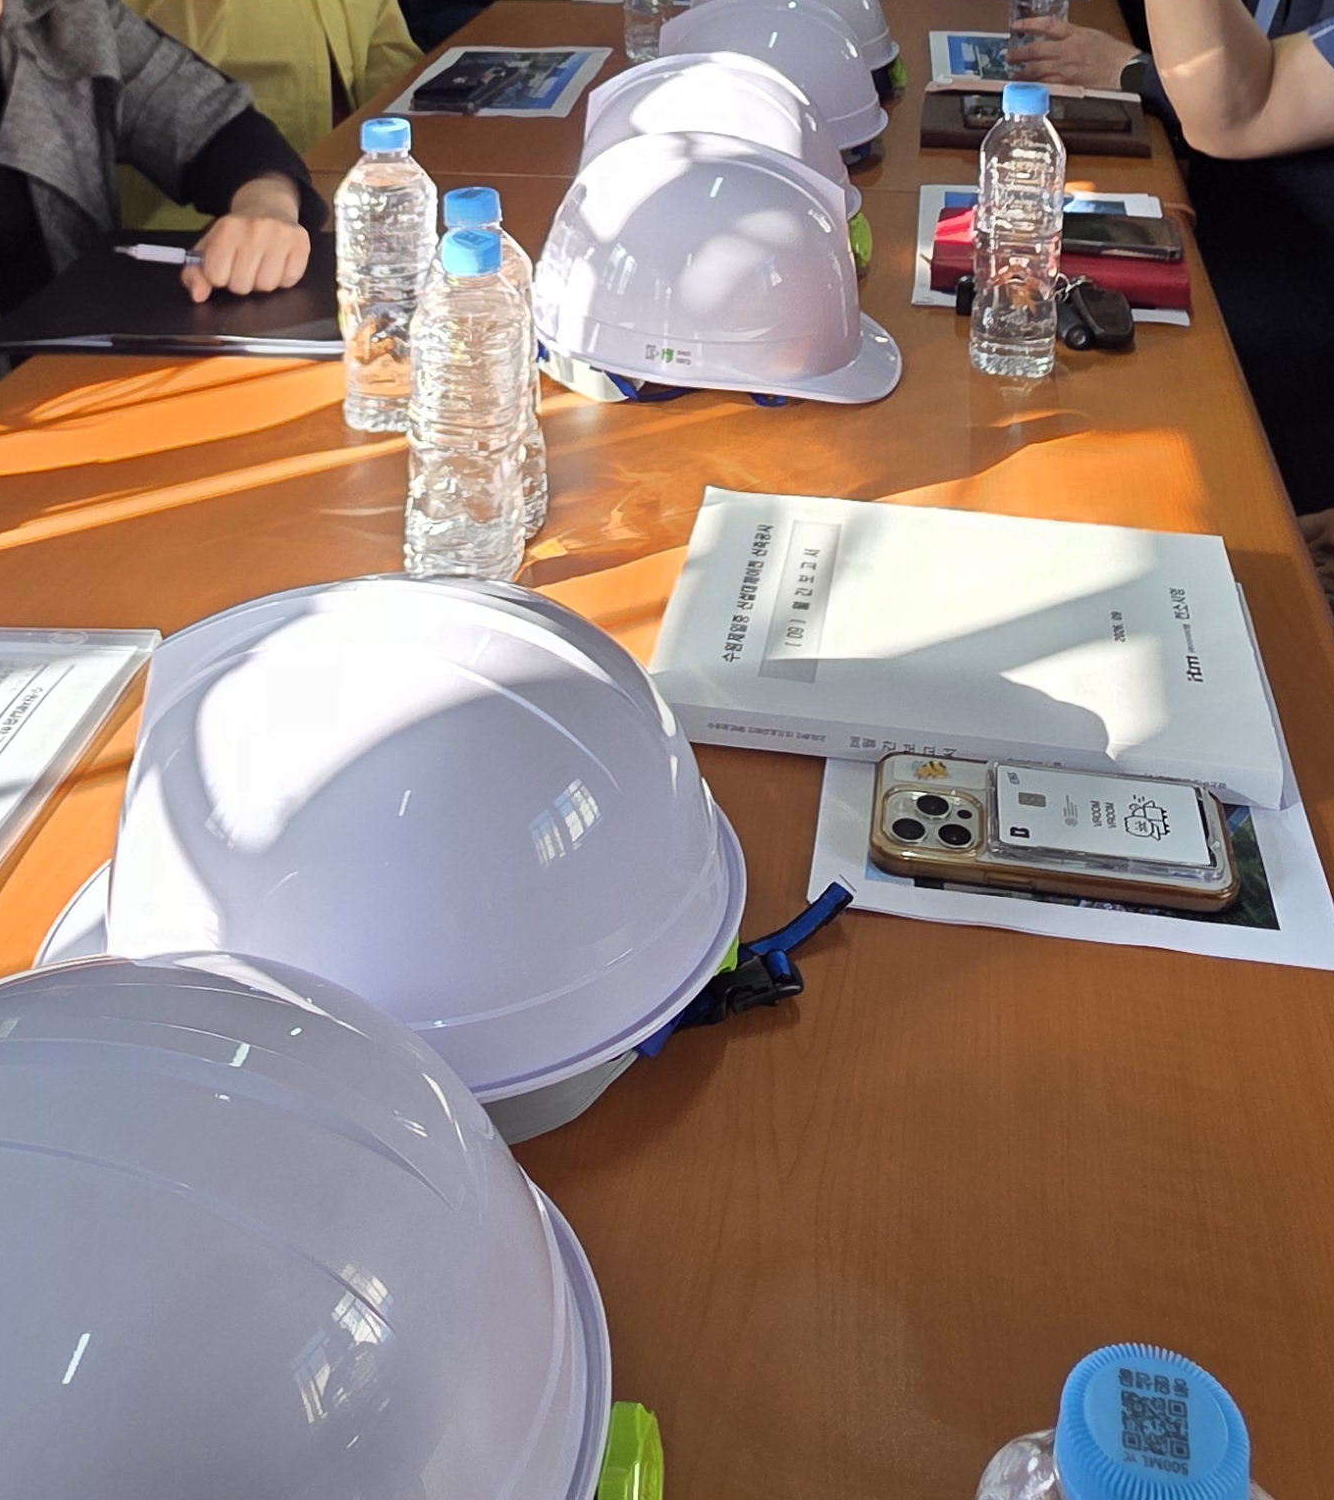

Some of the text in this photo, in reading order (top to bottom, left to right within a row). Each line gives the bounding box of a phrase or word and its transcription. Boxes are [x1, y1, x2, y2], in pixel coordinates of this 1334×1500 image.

[750, 524, 773, 557] 신축공사
[1119, 1368, 1189, 1397] 동원샘물
[1143, 1456, 1189, 1475] 500ML
